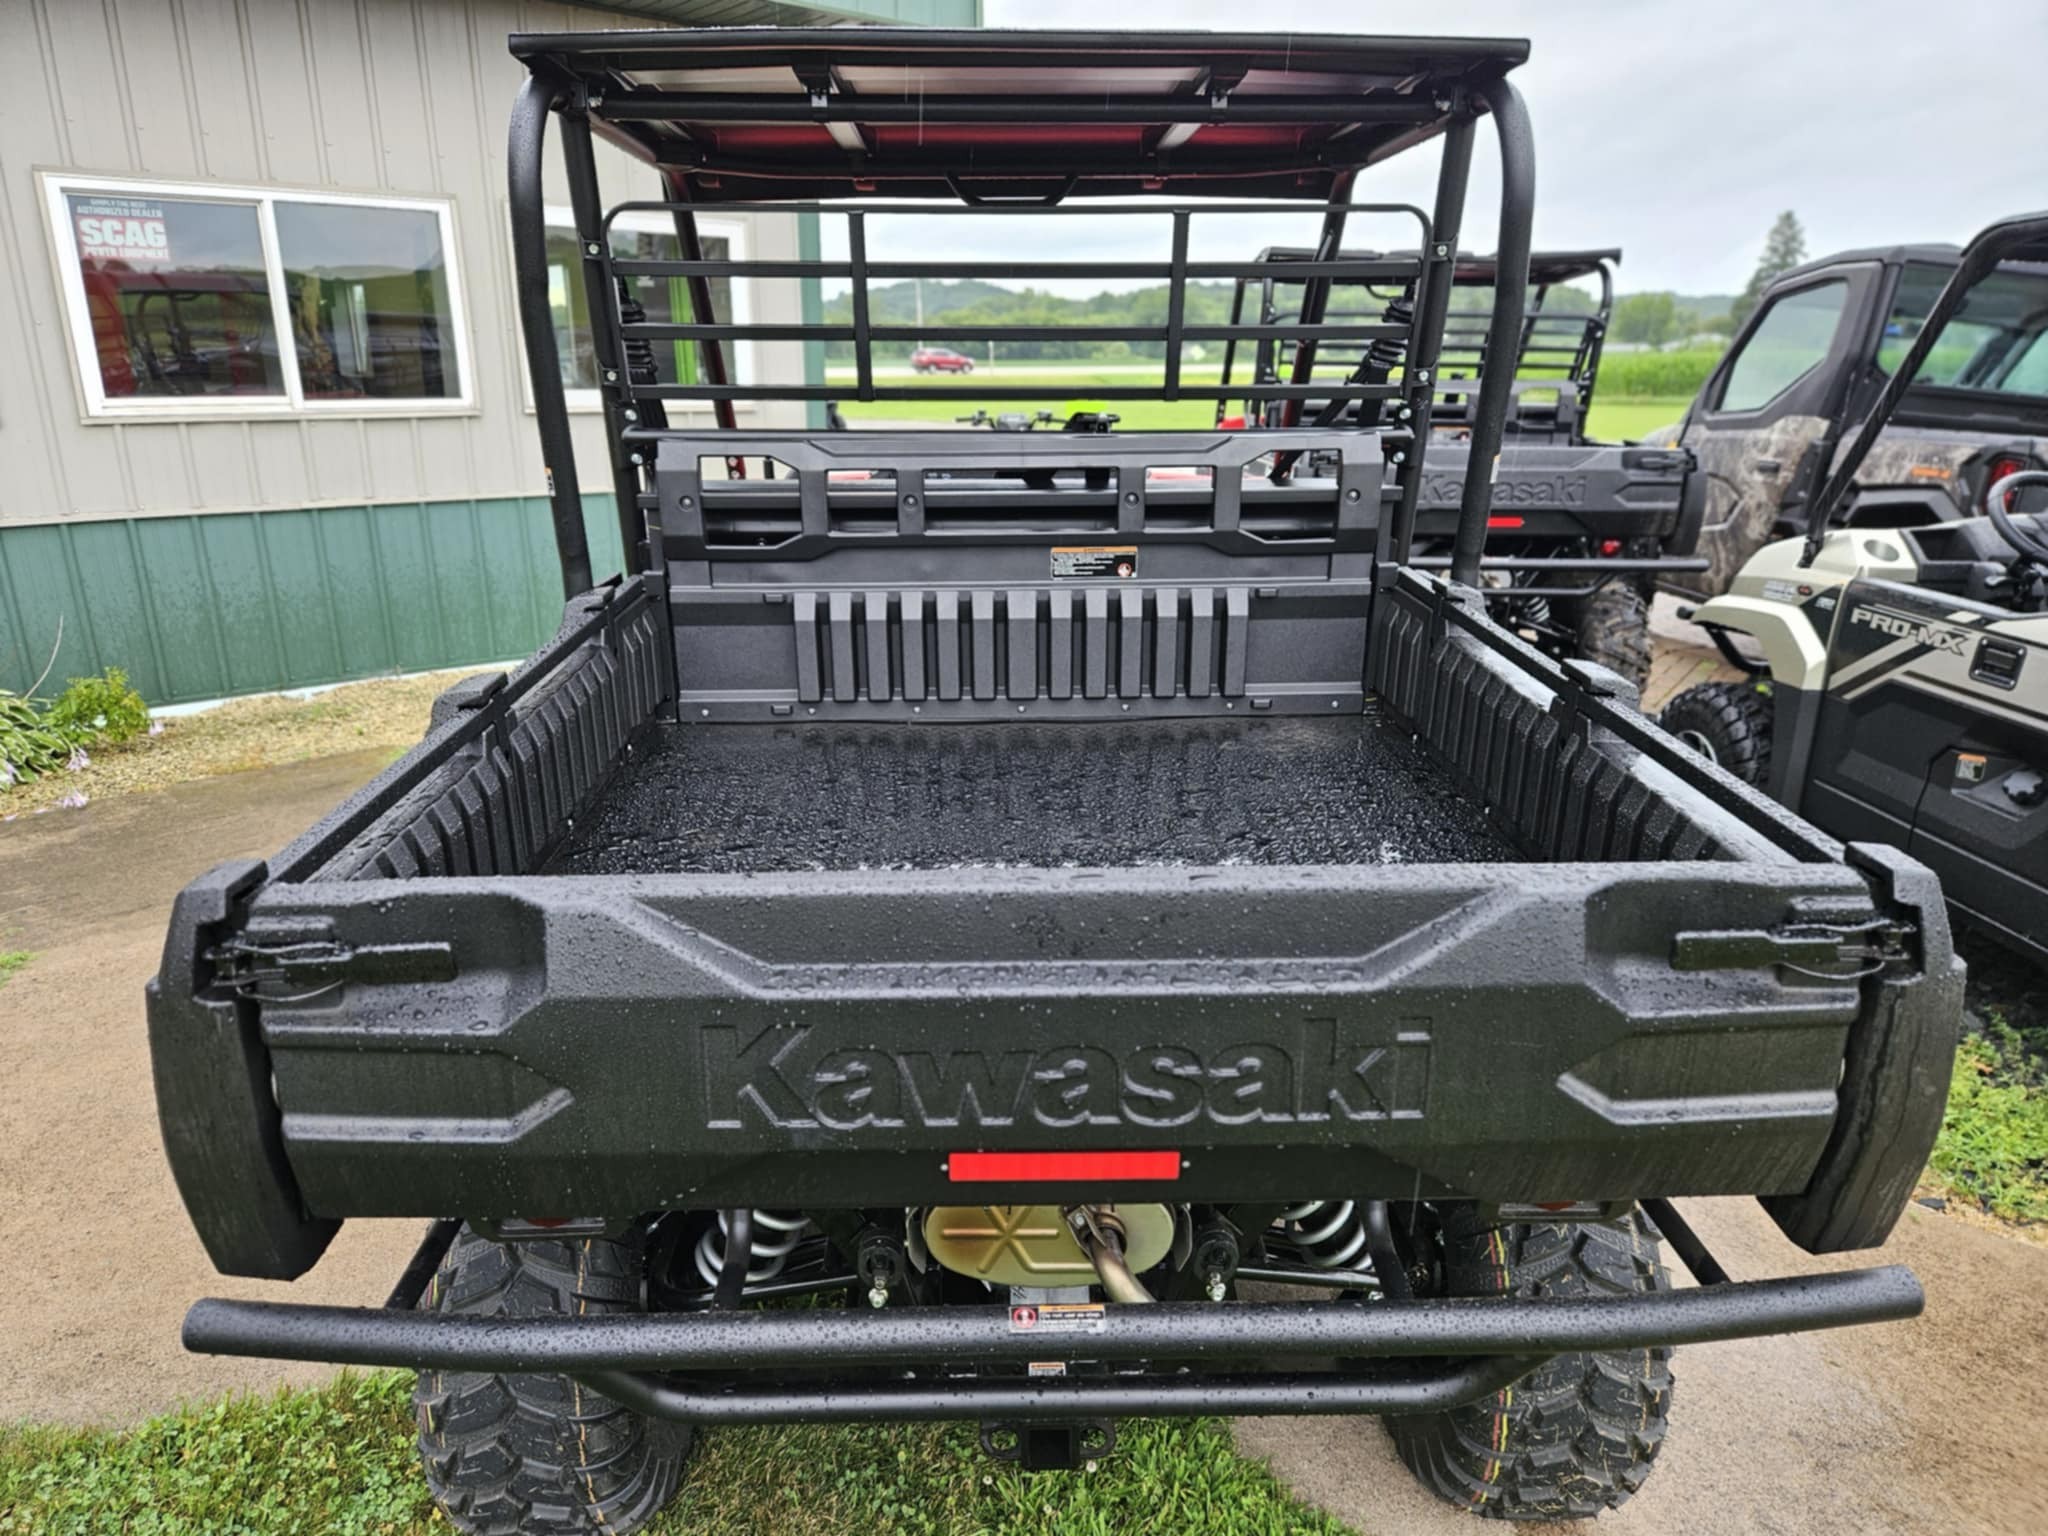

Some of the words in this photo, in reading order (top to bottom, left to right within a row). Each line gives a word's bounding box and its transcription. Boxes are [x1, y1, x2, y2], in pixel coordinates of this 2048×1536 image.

[76, 205, 130, 216] AUTHORIZED
[131, 207, 163, 218] DEALER
[79, 218, 167, 247] SCAG
[1419, 474, 1587, 505] Kaasaki
[1851, 607, 1968, 656] PRO-MX
[700, 1017, 1434, 1131] Kawasaki
